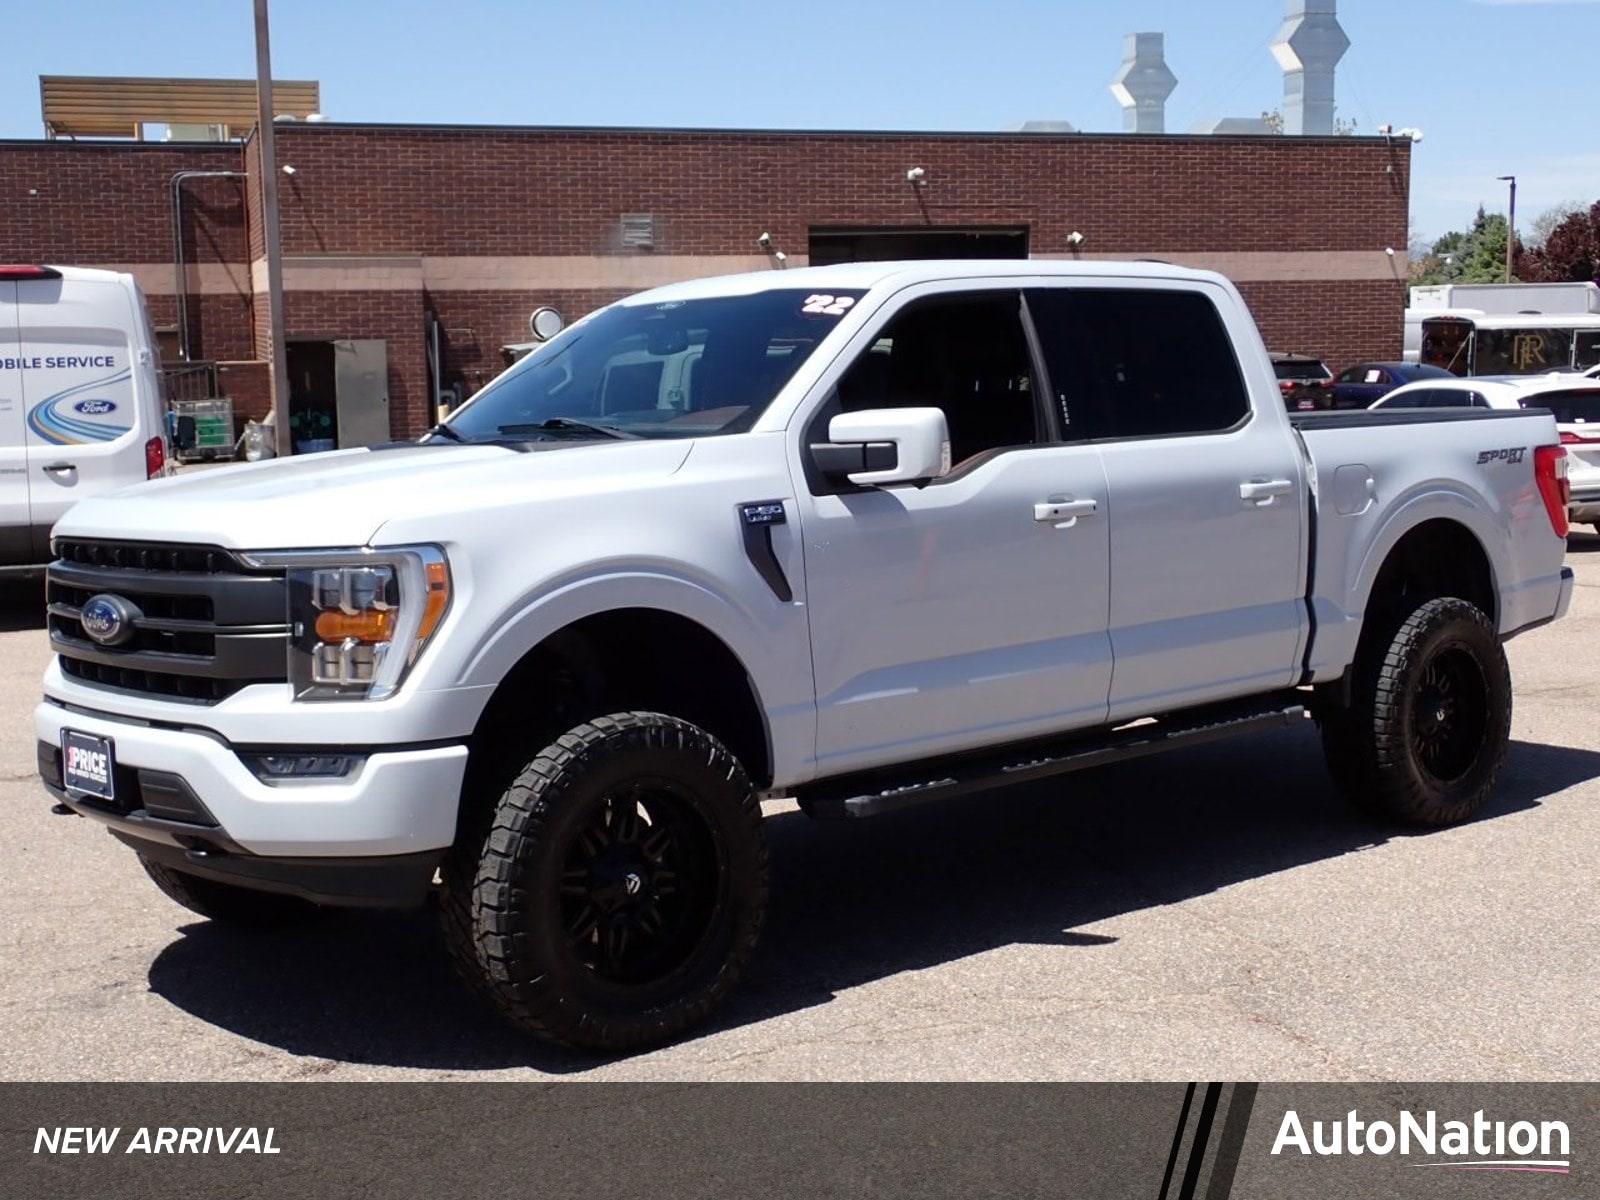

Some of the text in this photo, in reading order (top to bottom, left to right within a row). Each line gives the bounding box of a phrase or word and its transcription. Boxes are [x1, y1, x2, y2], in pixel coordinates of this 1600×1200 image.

[45, 356, 115, 368] SERVICE
[81, 401, 111, 413] Ford
[1477, 446, 1527, 464] SPORT
